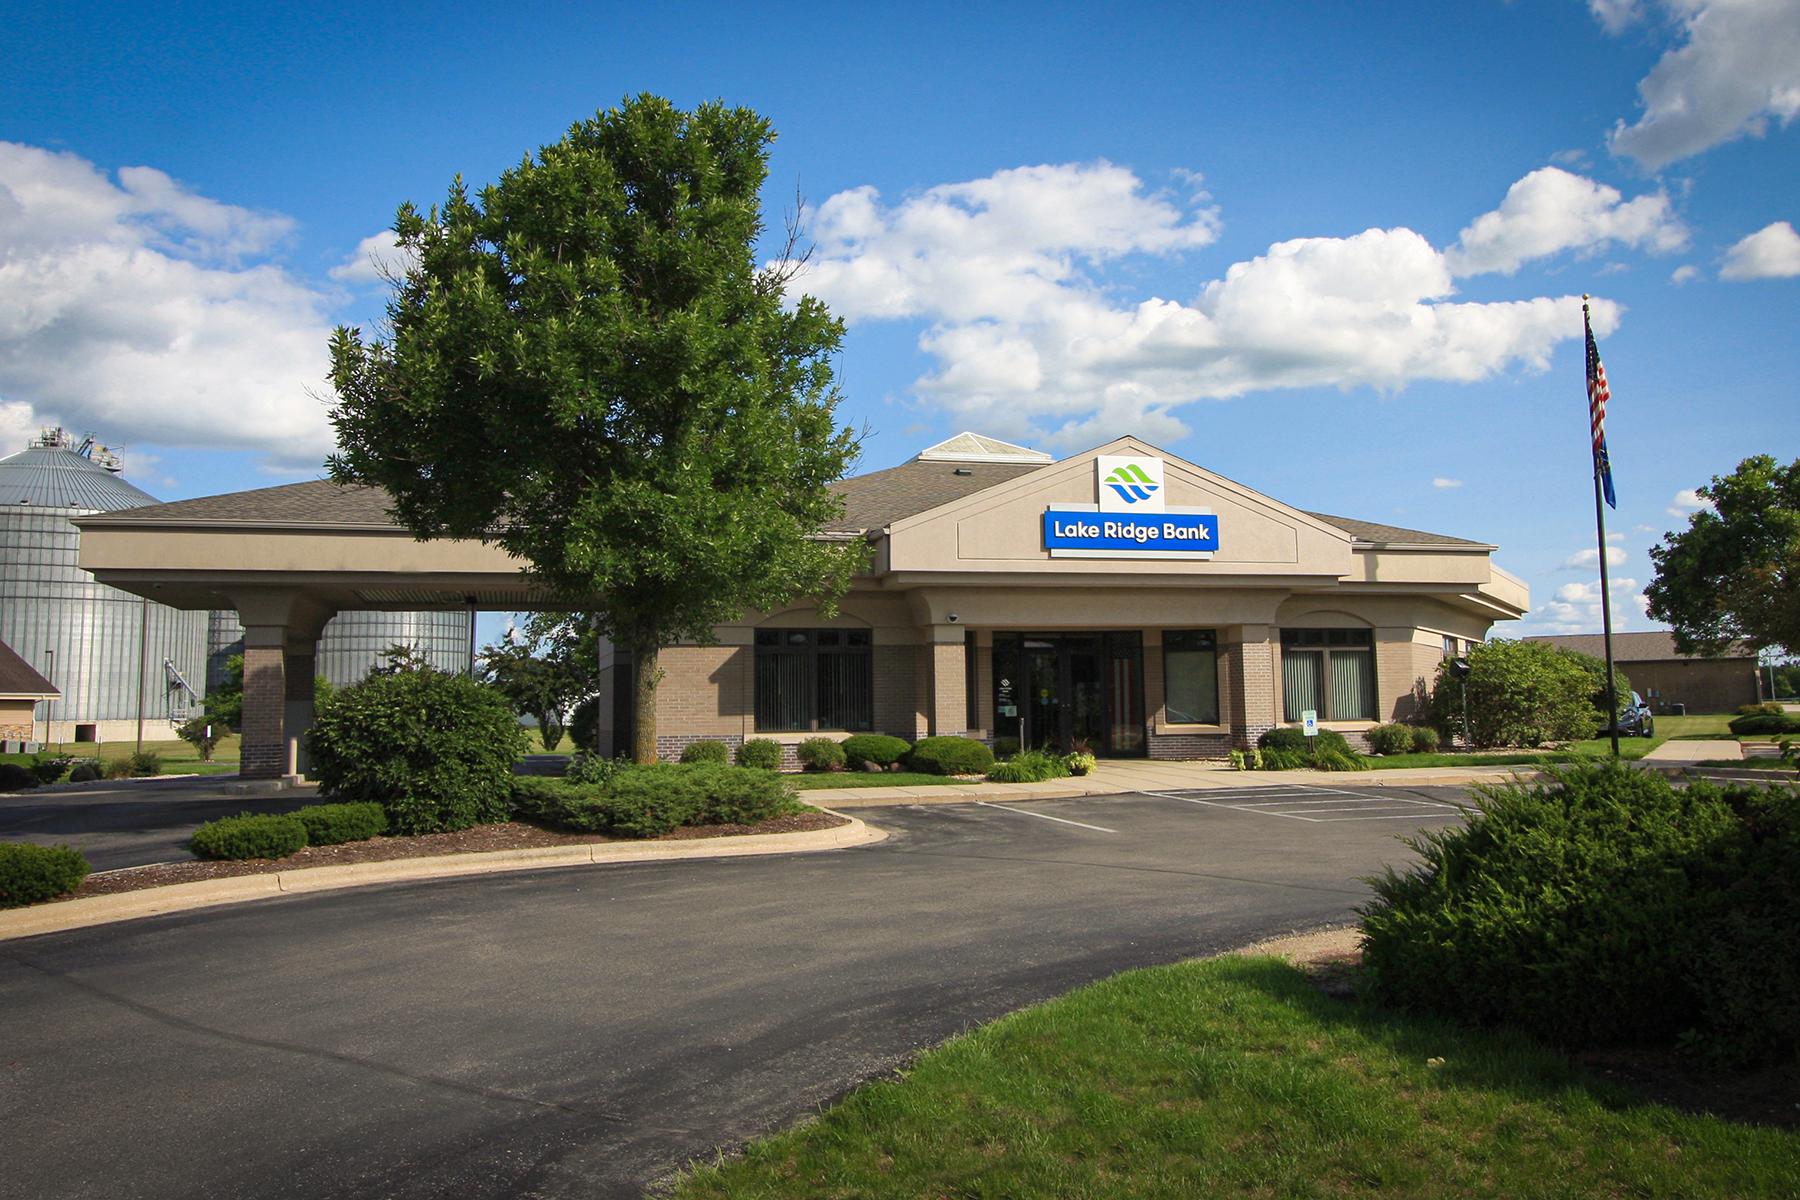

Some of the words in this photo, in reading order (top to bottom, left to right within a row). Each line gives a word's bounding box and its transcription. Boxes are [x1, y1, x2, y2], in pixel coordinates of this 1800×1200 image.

[1054, 520, 1100, 538] Lake
[1104, 521, 1159, 543] Ridge
[1163, 523, 1210, 540] Bank
